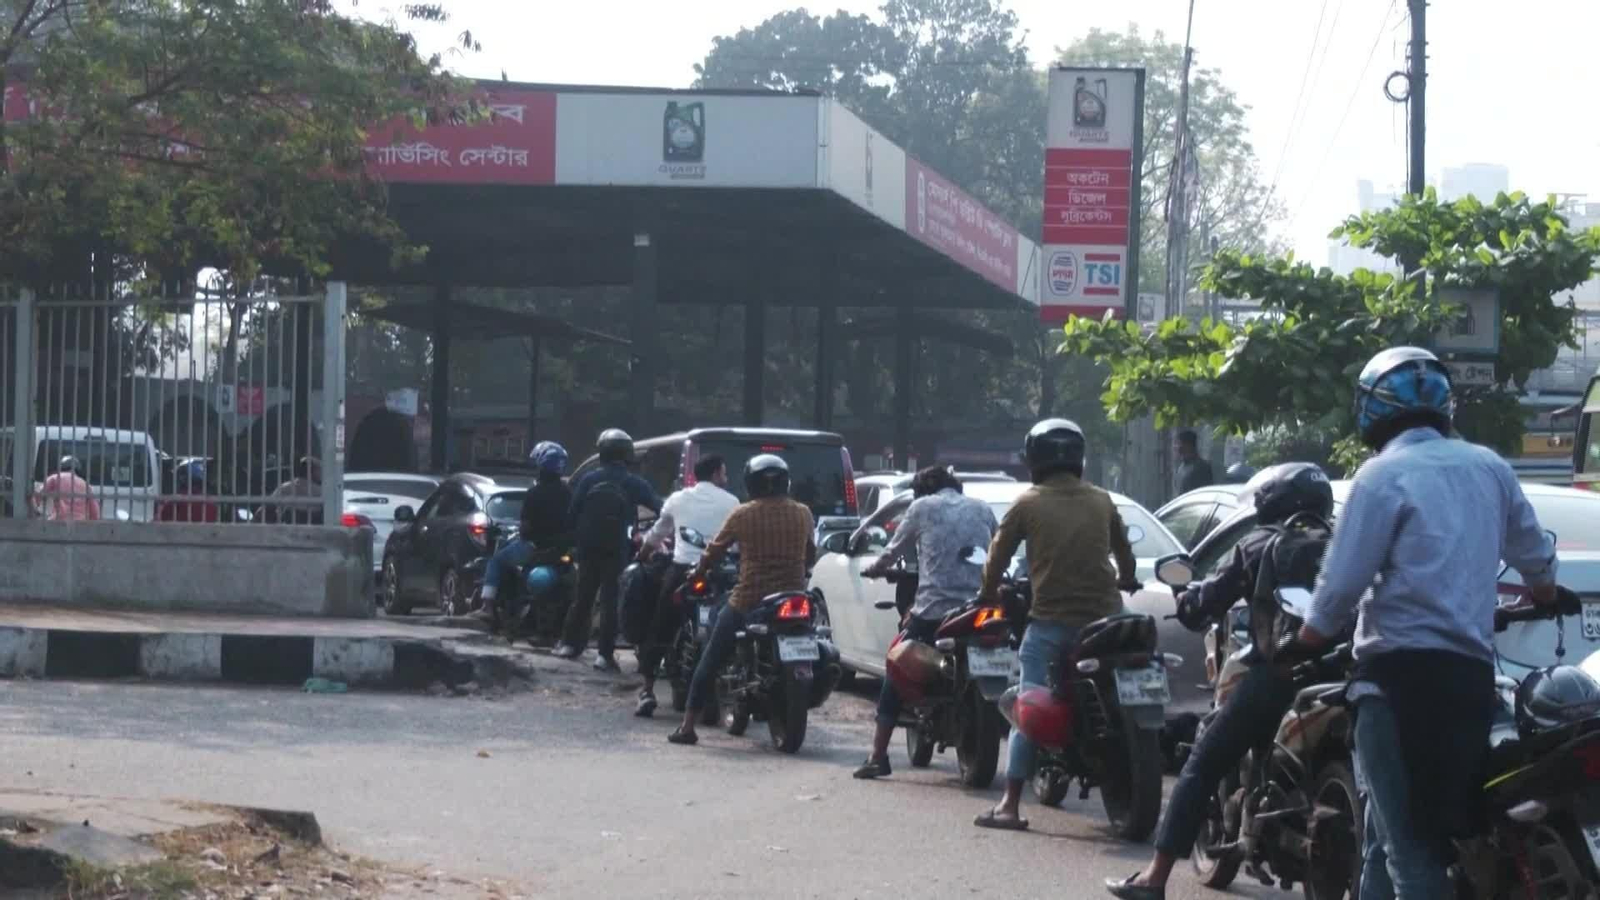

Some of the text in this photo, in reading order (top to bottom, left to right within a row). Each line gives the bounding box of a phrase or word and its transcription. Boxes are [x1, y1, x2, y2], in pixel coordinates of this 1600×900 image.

[459, 144, 529, 167] সেন্টার
[1068, 188, 1107, 204] ডিজেল
[1084, 263, 1120, 285] TSI
